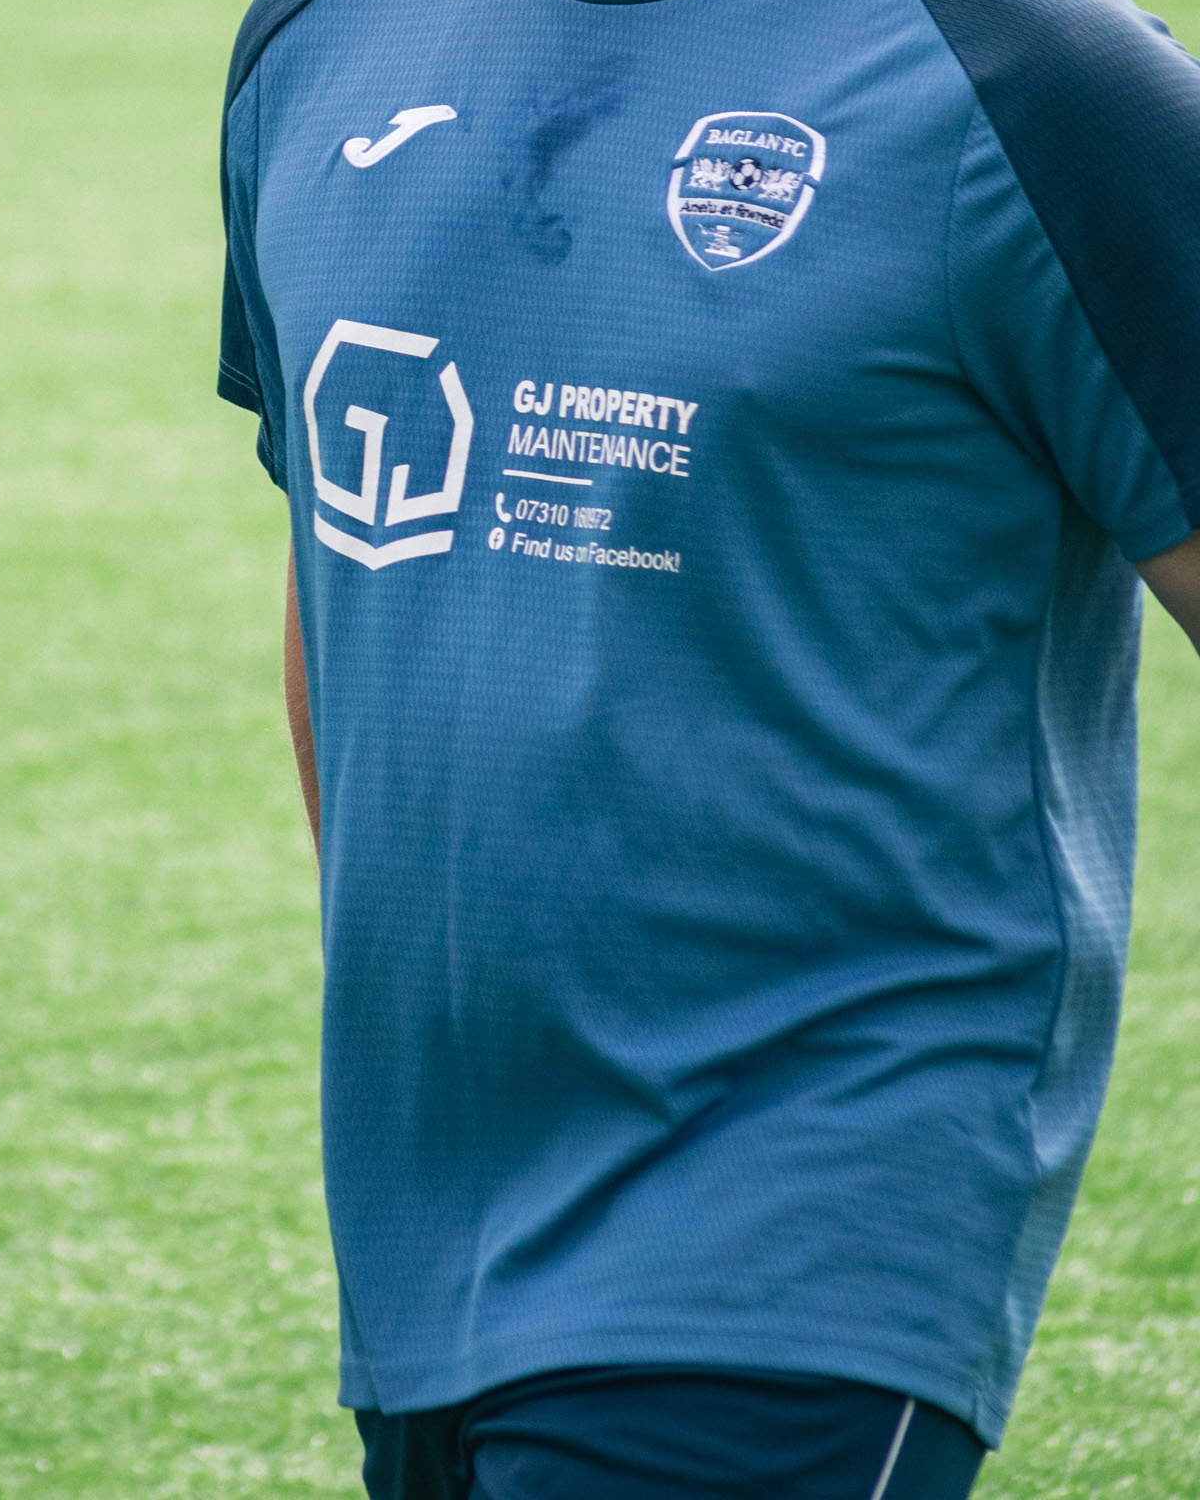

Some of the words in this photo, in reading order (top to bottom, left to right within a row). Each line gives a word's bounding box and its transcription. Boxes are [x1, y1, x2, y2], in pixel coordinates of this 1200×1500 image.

[705, 128, 782, 151] BAGLAN
[781, 136, 809, 158] FC
[513, 380, 554, 416] GJ
[558, 384, 699, 435] PROPERTY
[507, 424, 692, 478] MAINTENANCE
[515, 499, 569, 527] 07310
[511, 532, 552, 558] Find
[554, 544, 575, 563] us
